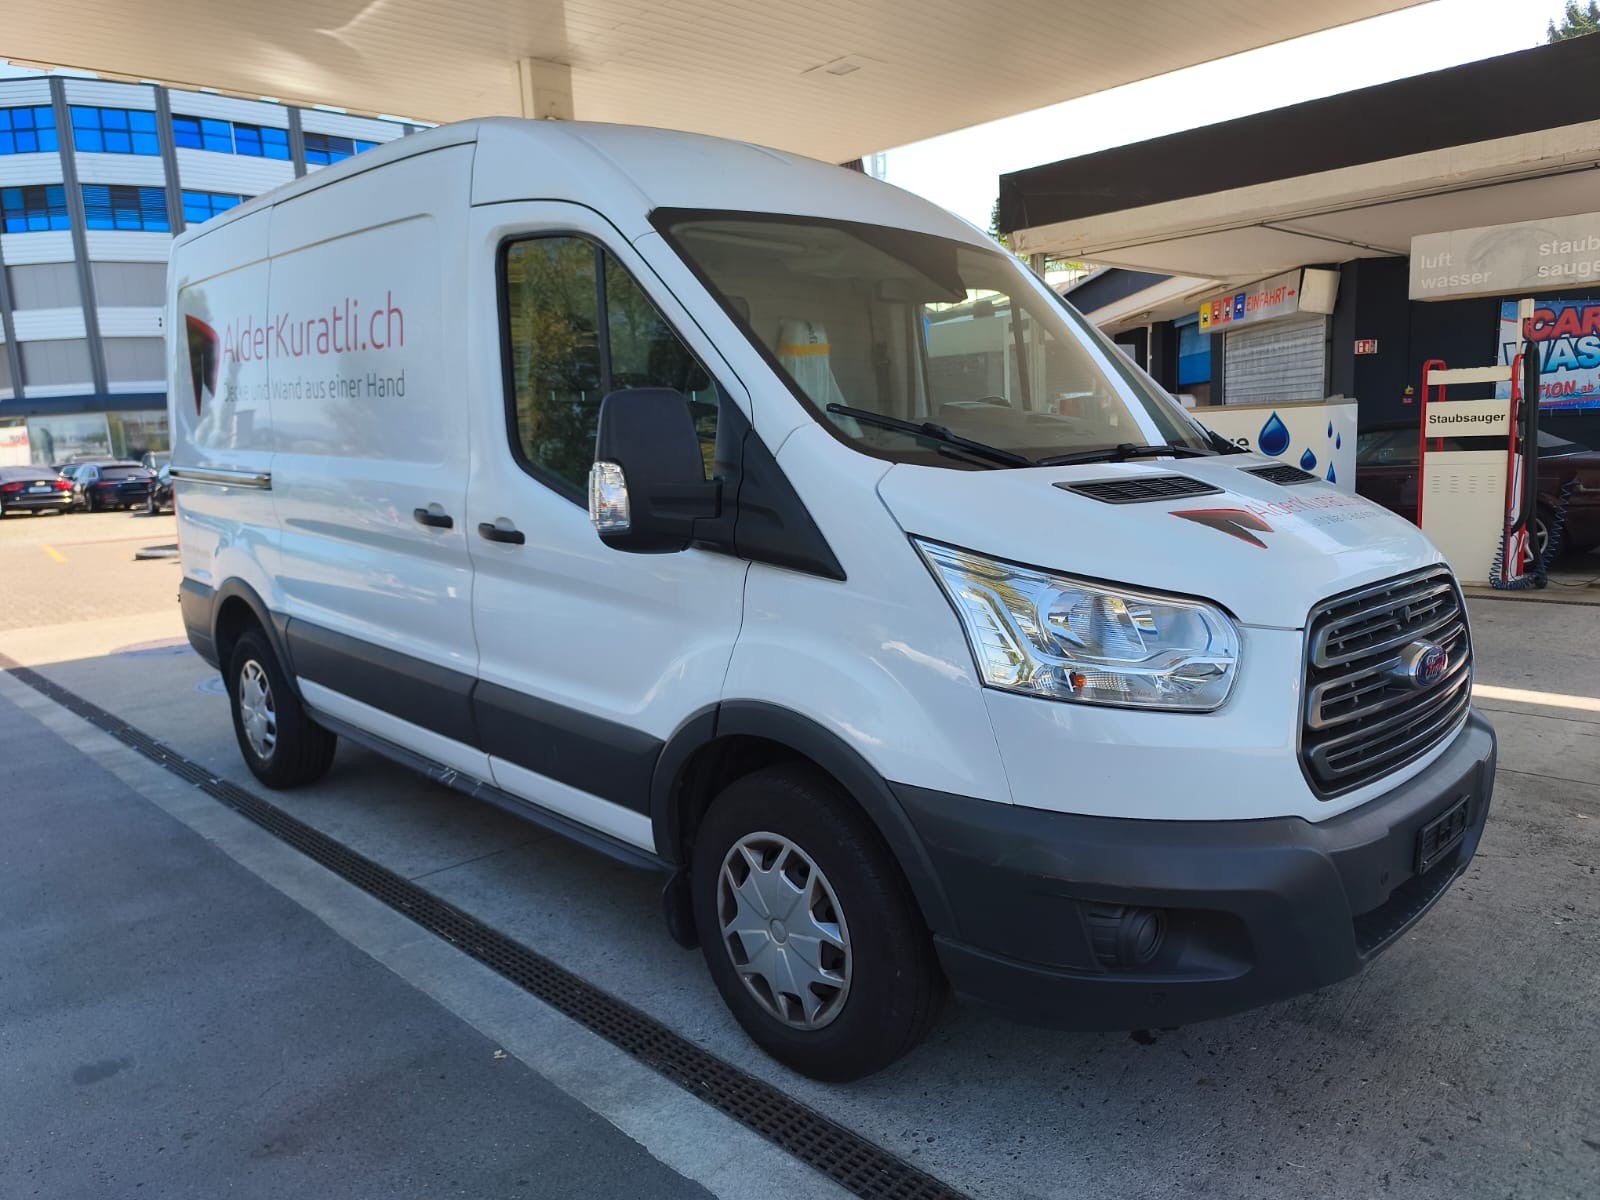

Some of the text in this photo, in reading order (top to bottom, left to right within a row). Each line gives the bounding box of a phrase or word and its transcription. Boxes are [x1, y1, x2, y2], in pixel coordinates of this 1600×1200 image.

[1420, 254, 1453, 269] luft
[1421, 271, 1492, 289] wasser
[1246, 286, 1287, 312] EINFAHRT
[223, 290, 405, 364] AlderKuratli.ch
[271, 376, 302, 401] Wand
[305, 380, 326, 399] aus
[328, 373, 363, 398] einer
[366, 368, 405, 398] Hand
[1429, 413, 1506, 425] Staubsauger
